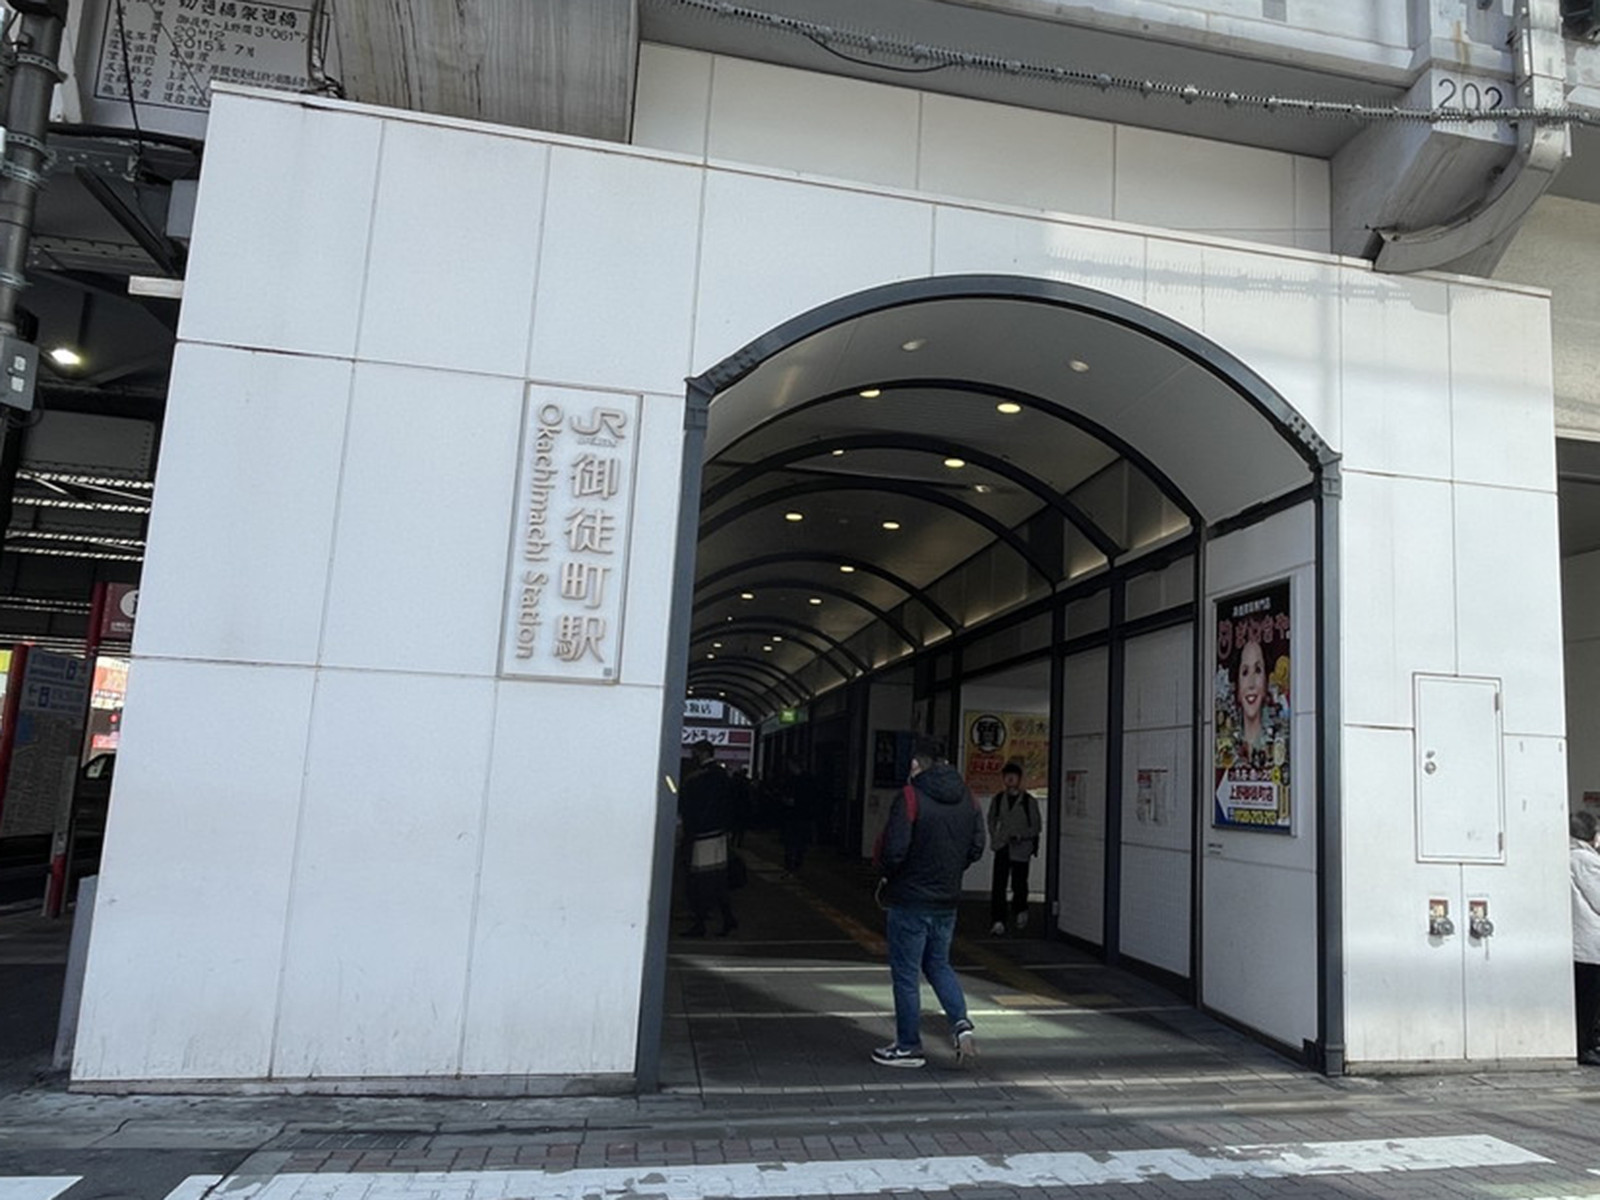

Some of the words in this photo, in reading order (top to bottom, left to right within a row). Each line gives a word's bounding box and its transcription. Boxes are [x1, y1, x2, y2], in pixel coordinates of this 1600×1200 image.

[1438, 78, 1503, 111] 202
[569, 406, 627, 440] JR
[524, 403, 564, 563] Okachimachi
[553, 453, 620, 664] 御徒町駅
[516, 570, 548, 660] Station
